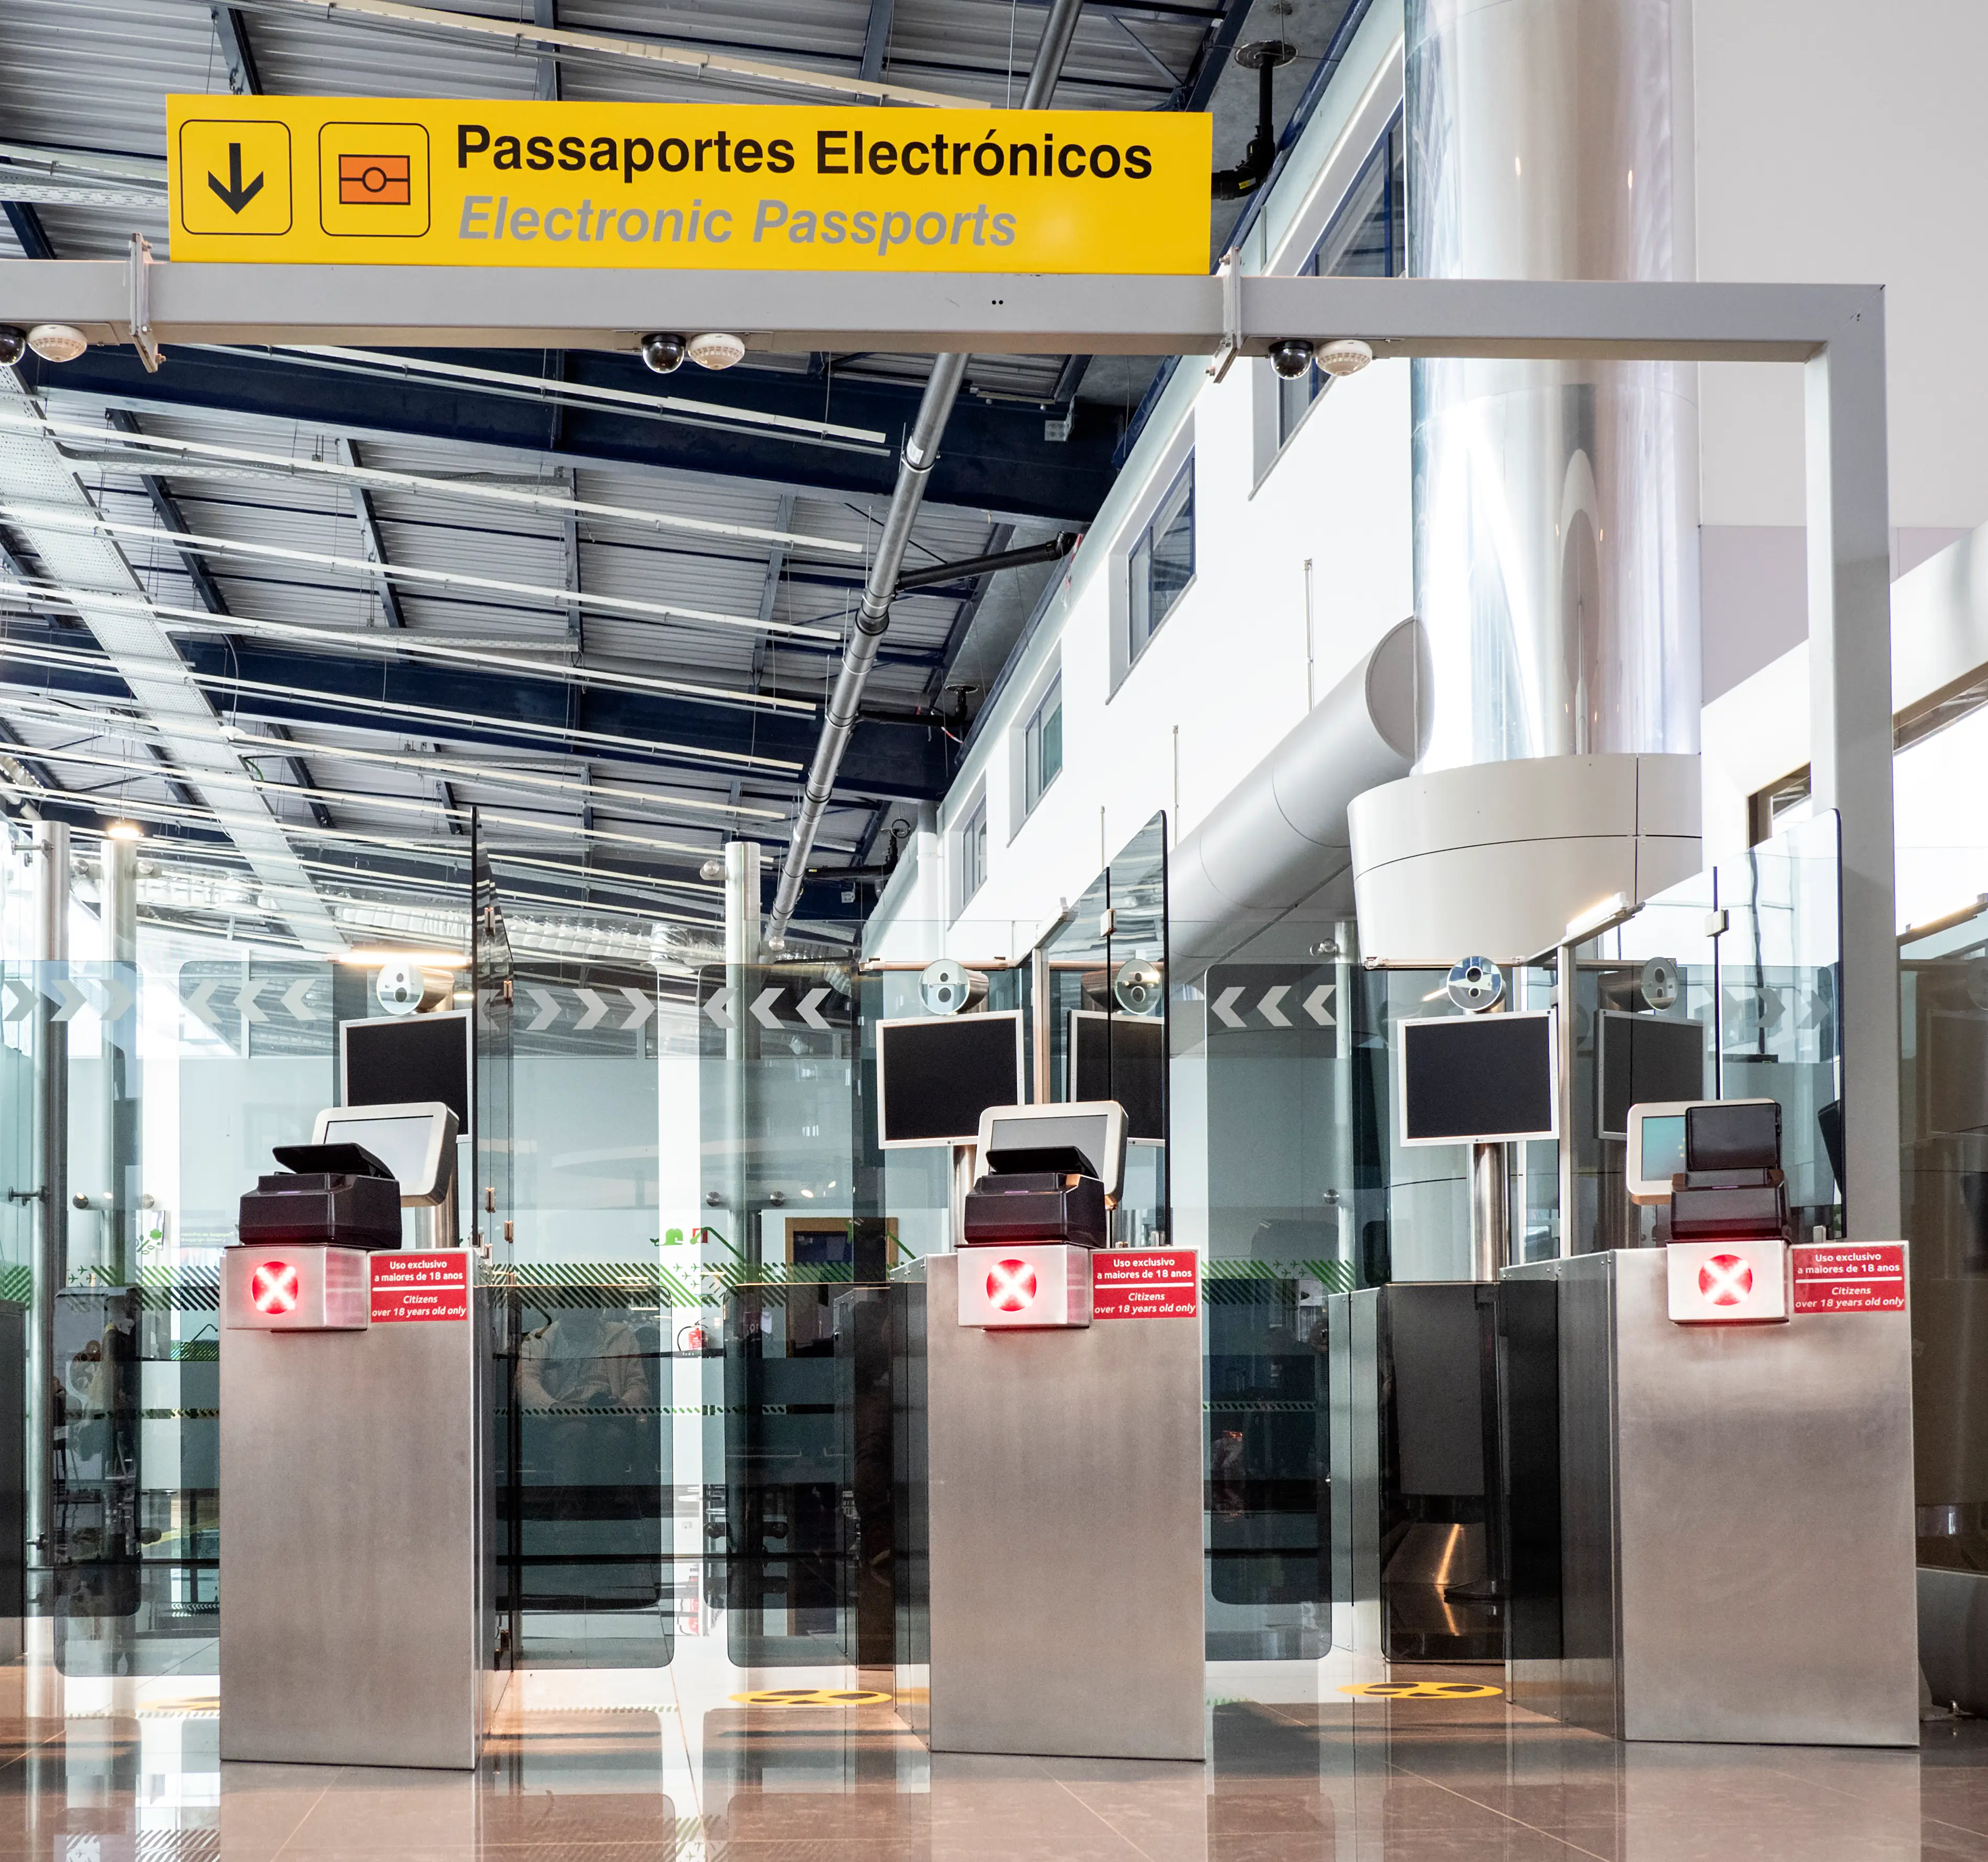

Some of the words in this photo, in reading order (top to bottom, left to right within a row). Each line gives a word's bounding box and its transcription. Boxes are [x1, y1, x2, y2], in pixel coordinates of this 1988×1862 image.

[457, 124, 795, 184] Passaportes
[817, 129, 1152, 180] Electrónicos
[458, 195, 733, 243] Electronic
[752, 199, 1018, 257] Passports
[1836, 1252, 1881, 1261] exclusivo
[408, 1259, 447, 1268] exclusivo
[1133, 1258, 1175, 1266] exclusivo
[1846, 1264, 1858, 1273] de
[381, 1273, 414, 1281] maiores
[416, 1272, 427, 1280] de
[1142, 1269, 1153, 1278] de
[1156, 1269, 1168, 1278] 18
[1832, 1287, 1871, 1295] Citizens
[1128, 1293, 1165, 1301] Citizens
[1835, 1299, 1862, 1309] years
[1883, 1297, 1904, 1307] only
[394, 1308, 404, 1316] 18
[406, 1308, 430, 1318] years
[448, 1306, 467, 1316] only
[1132, 1305, 1157, 1315] years
[1159, 1303, 1173, 1312] old
[1176, 1303, 1195, 1314] only
